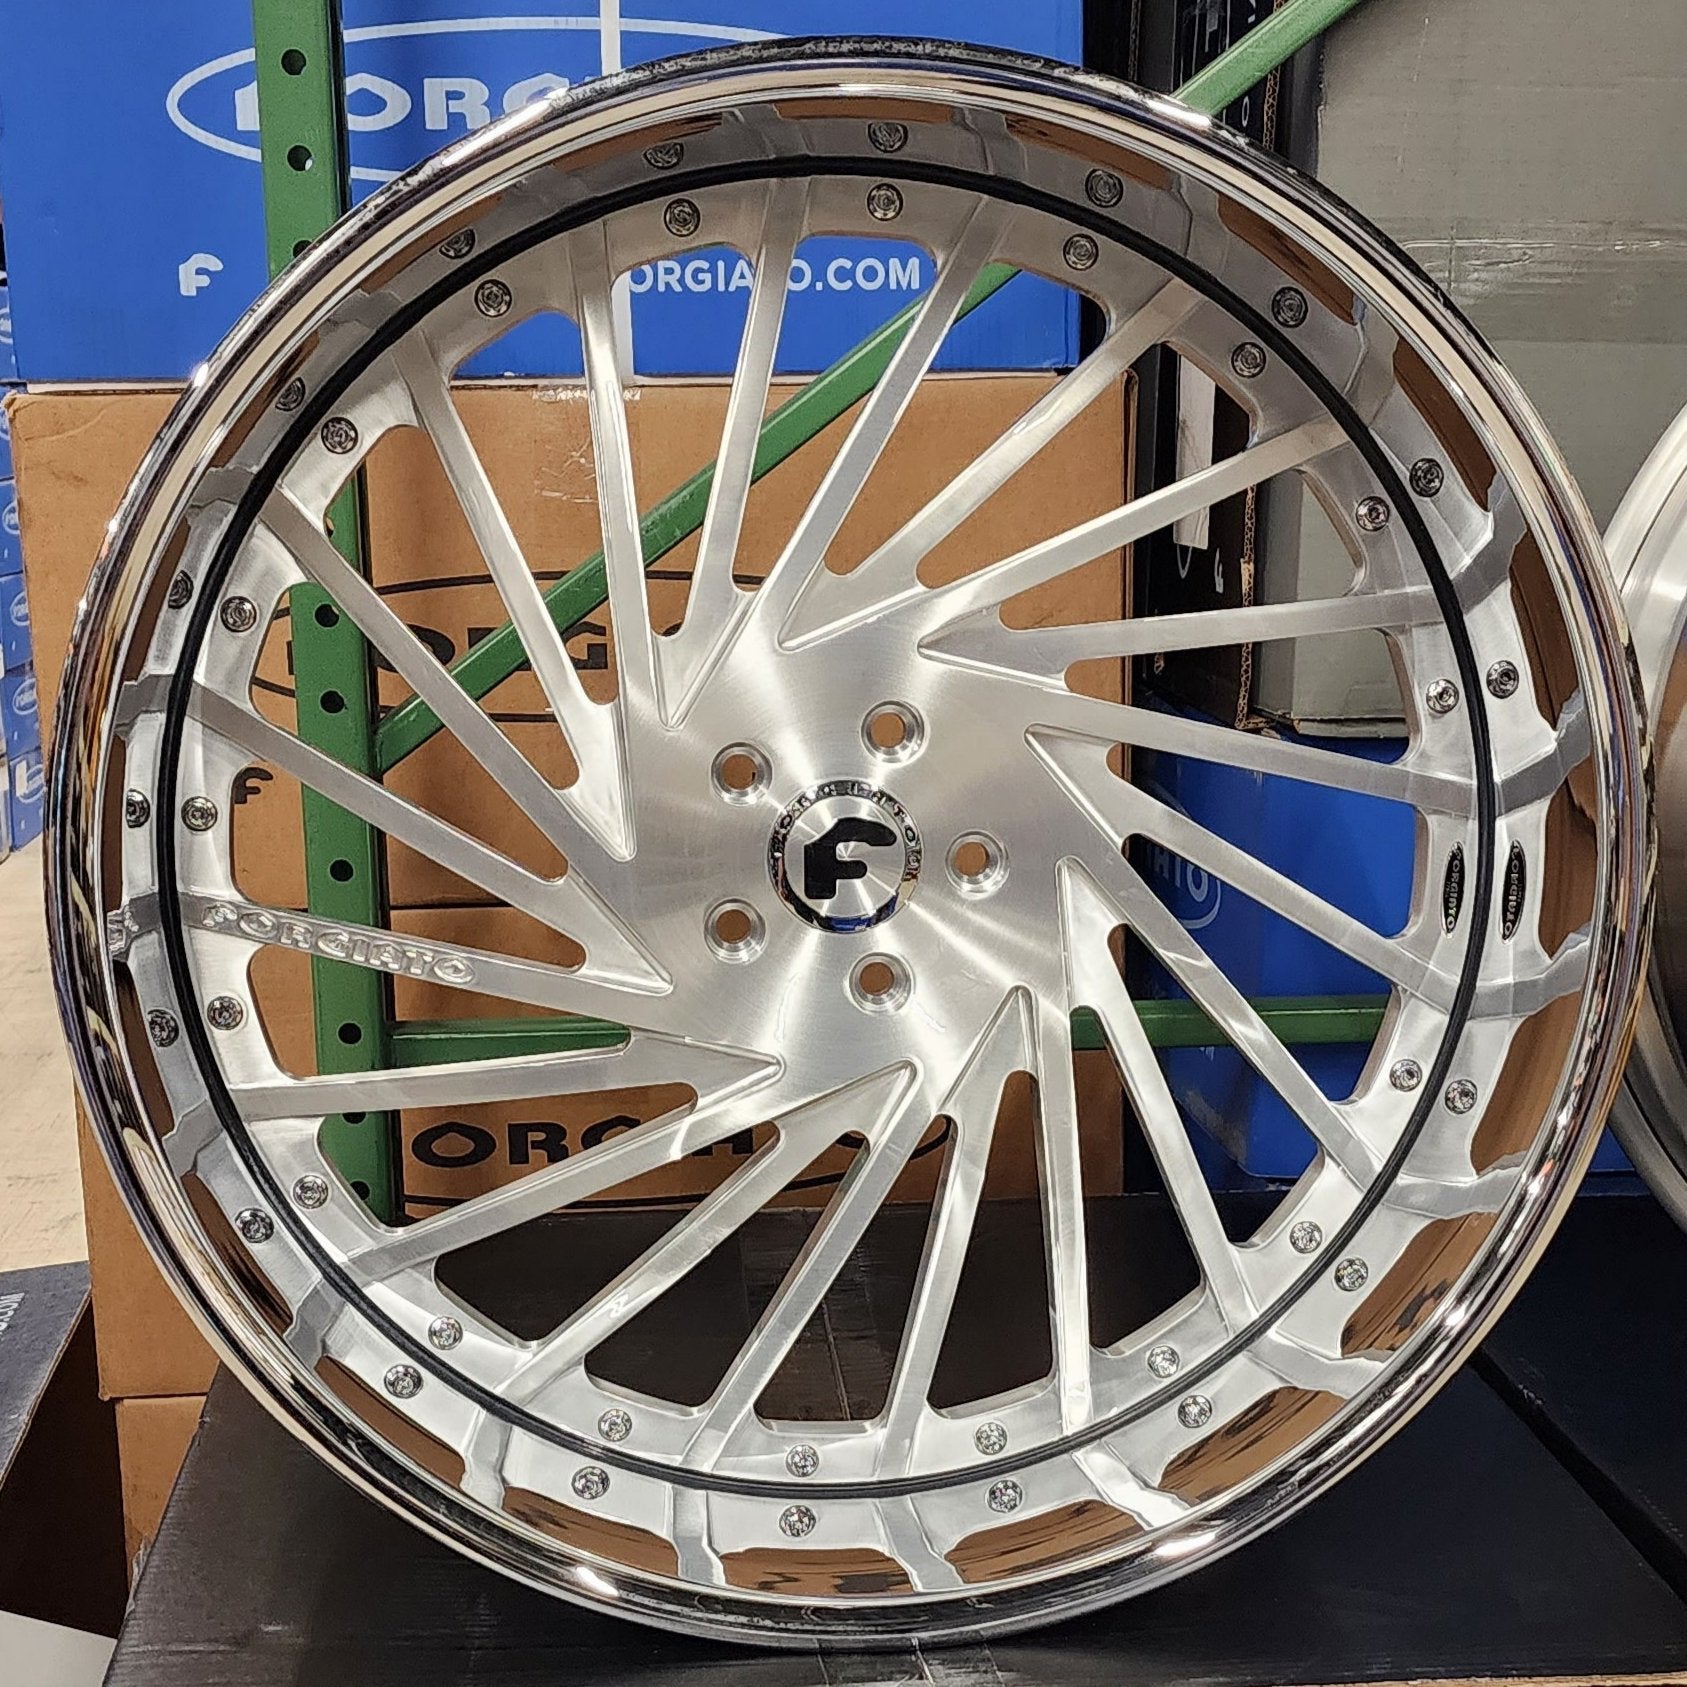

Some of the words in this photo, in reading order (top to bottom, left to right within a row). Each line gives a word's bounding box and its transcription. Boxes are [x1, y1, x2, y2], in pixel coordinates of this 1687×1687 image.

[179, 253, 223, 296] F
[628, 256, 920, 293] ORGIAO.COM
[803, 817, 898, 900] F
[202, 902, 475, 984] FORGIATO
